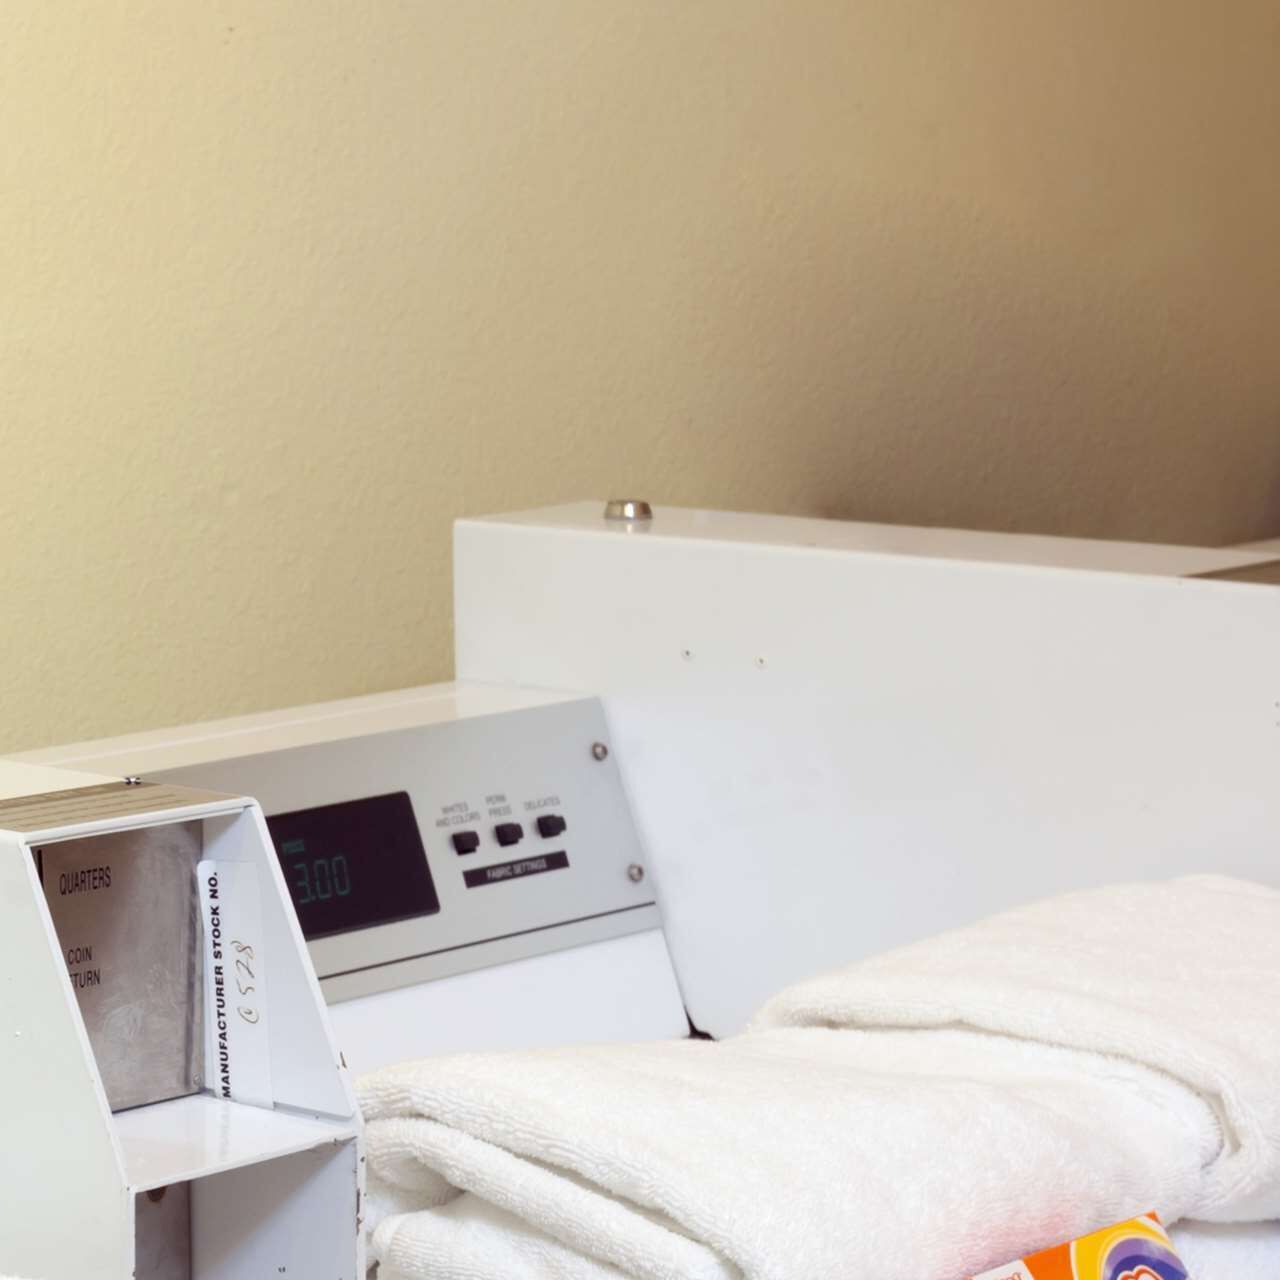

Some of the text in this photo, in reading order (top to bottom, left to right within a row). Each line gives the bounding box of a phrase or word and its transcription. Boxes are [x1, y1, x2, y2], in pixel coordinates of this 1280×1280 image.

[59, 866, 112, 895] QUARTERS
[292, 855, 352, 904] 3.00
[67, 947, 93, 965] COIN
[71, 968, 101, 988] TURN
[207, 871, 232, 1098] MANUFACTURER STOCK NO.
